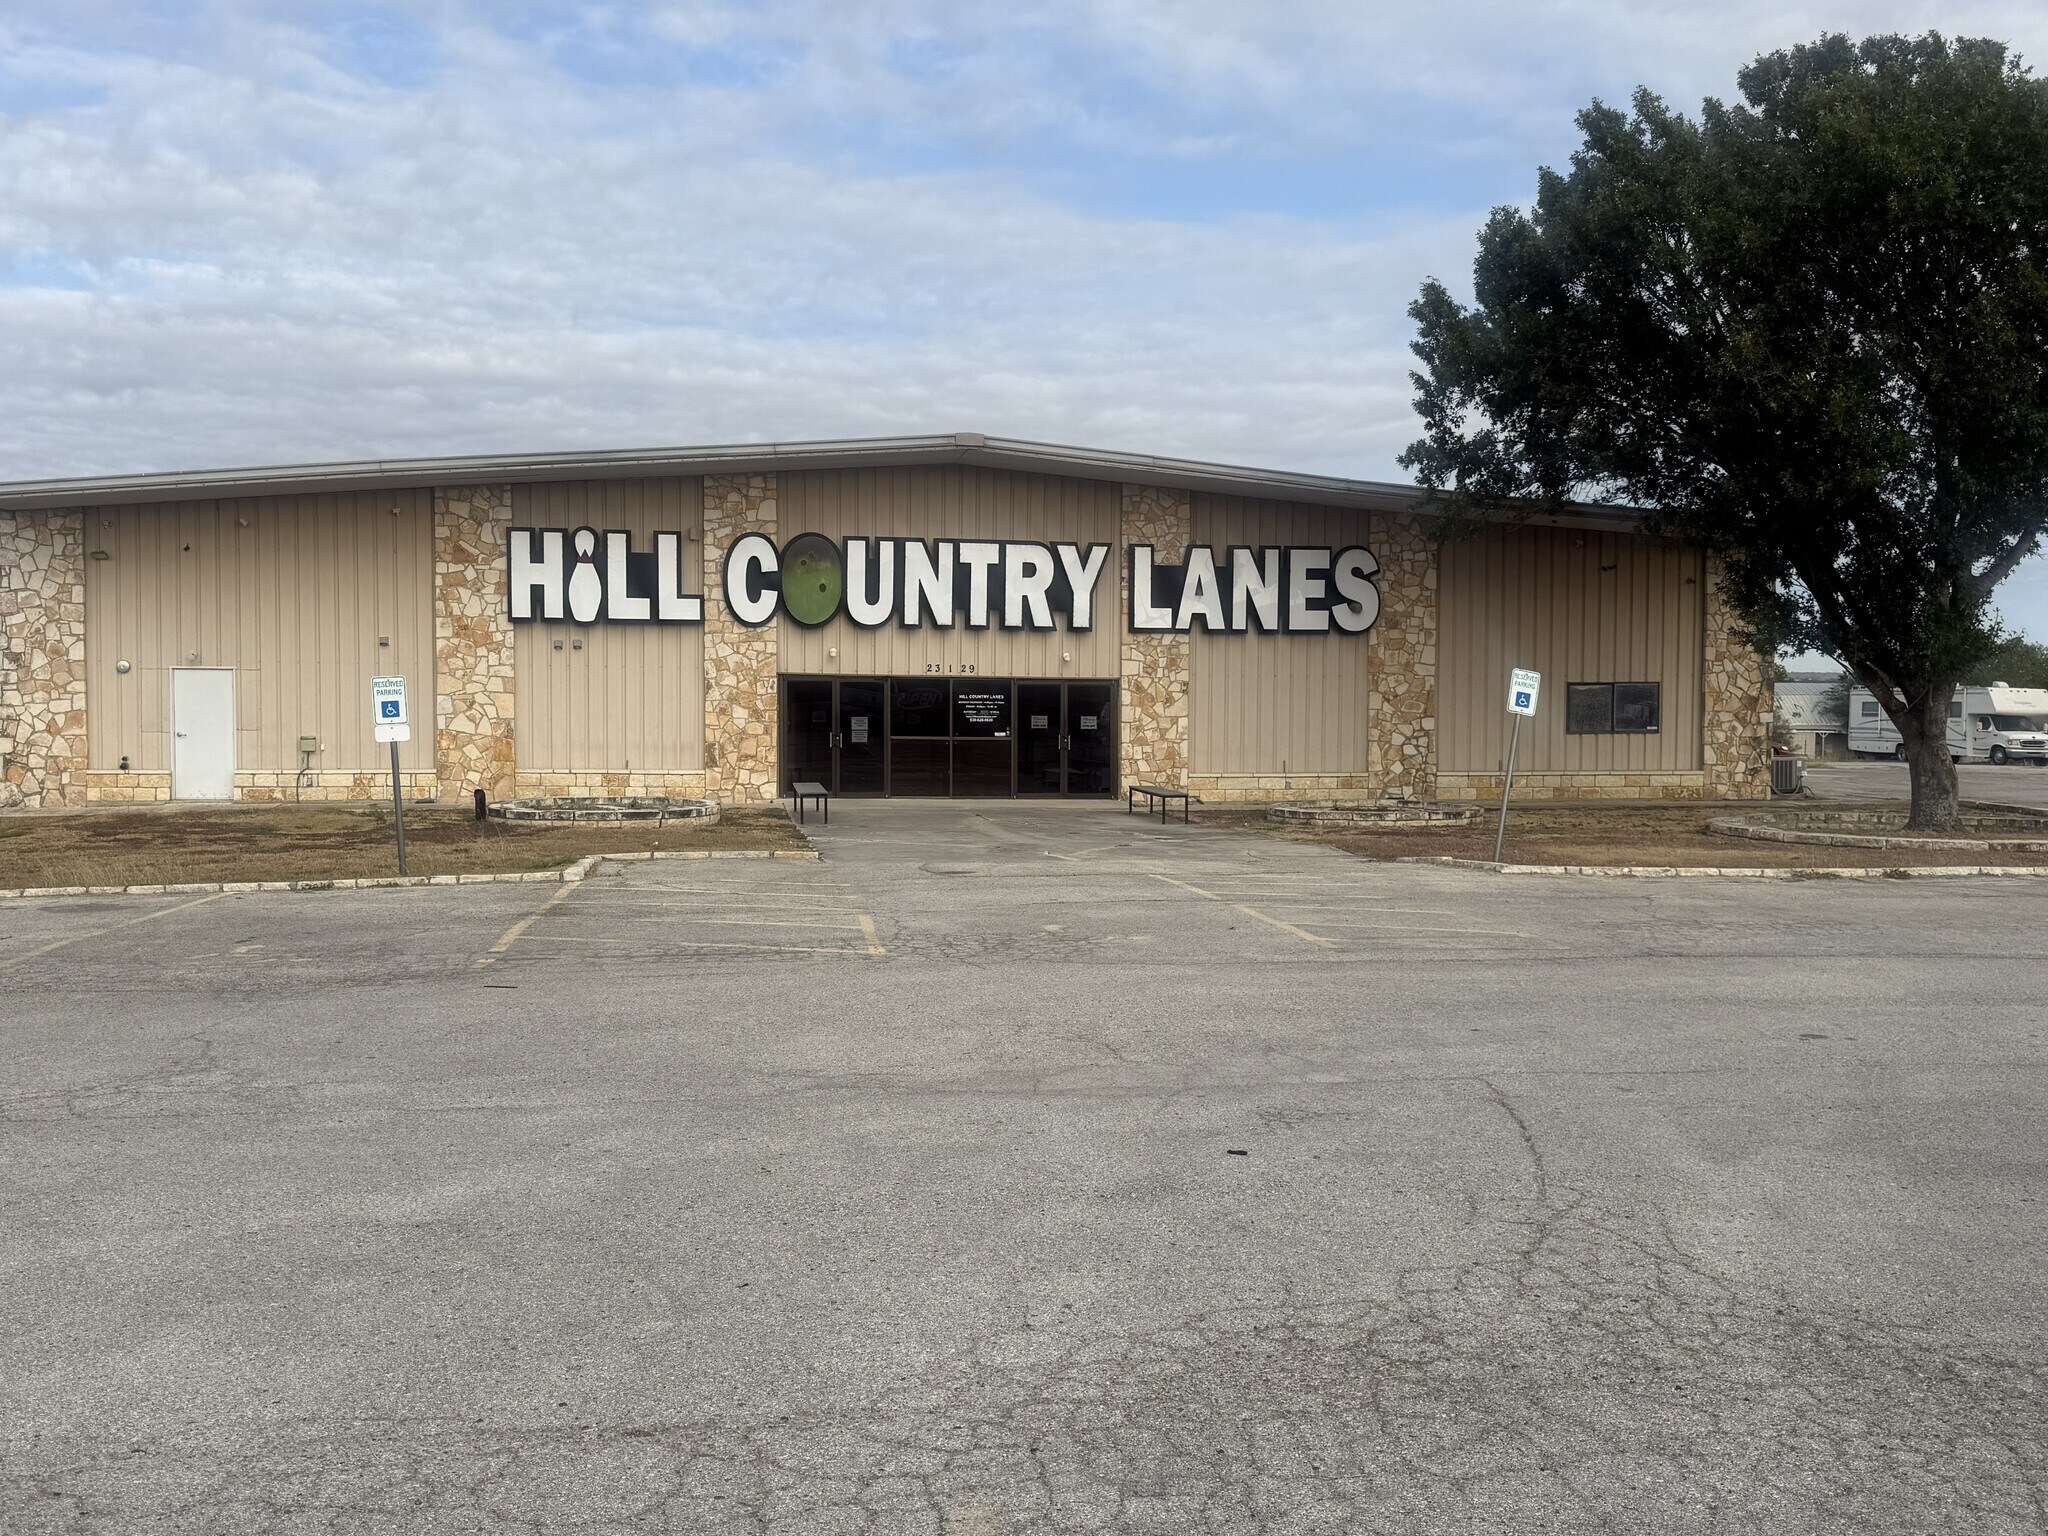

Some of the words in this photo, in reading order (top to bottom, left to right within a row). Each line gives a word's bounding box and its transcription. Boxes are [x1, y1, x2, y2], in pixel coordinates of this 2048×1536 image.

[726, 533, 1109, 629] COUNTRY
[1132, 547, 1381, 632] LANES
[1514, 672, 1538, 682] RESERVED
[1514, 680, 1536, 690] PARKING
